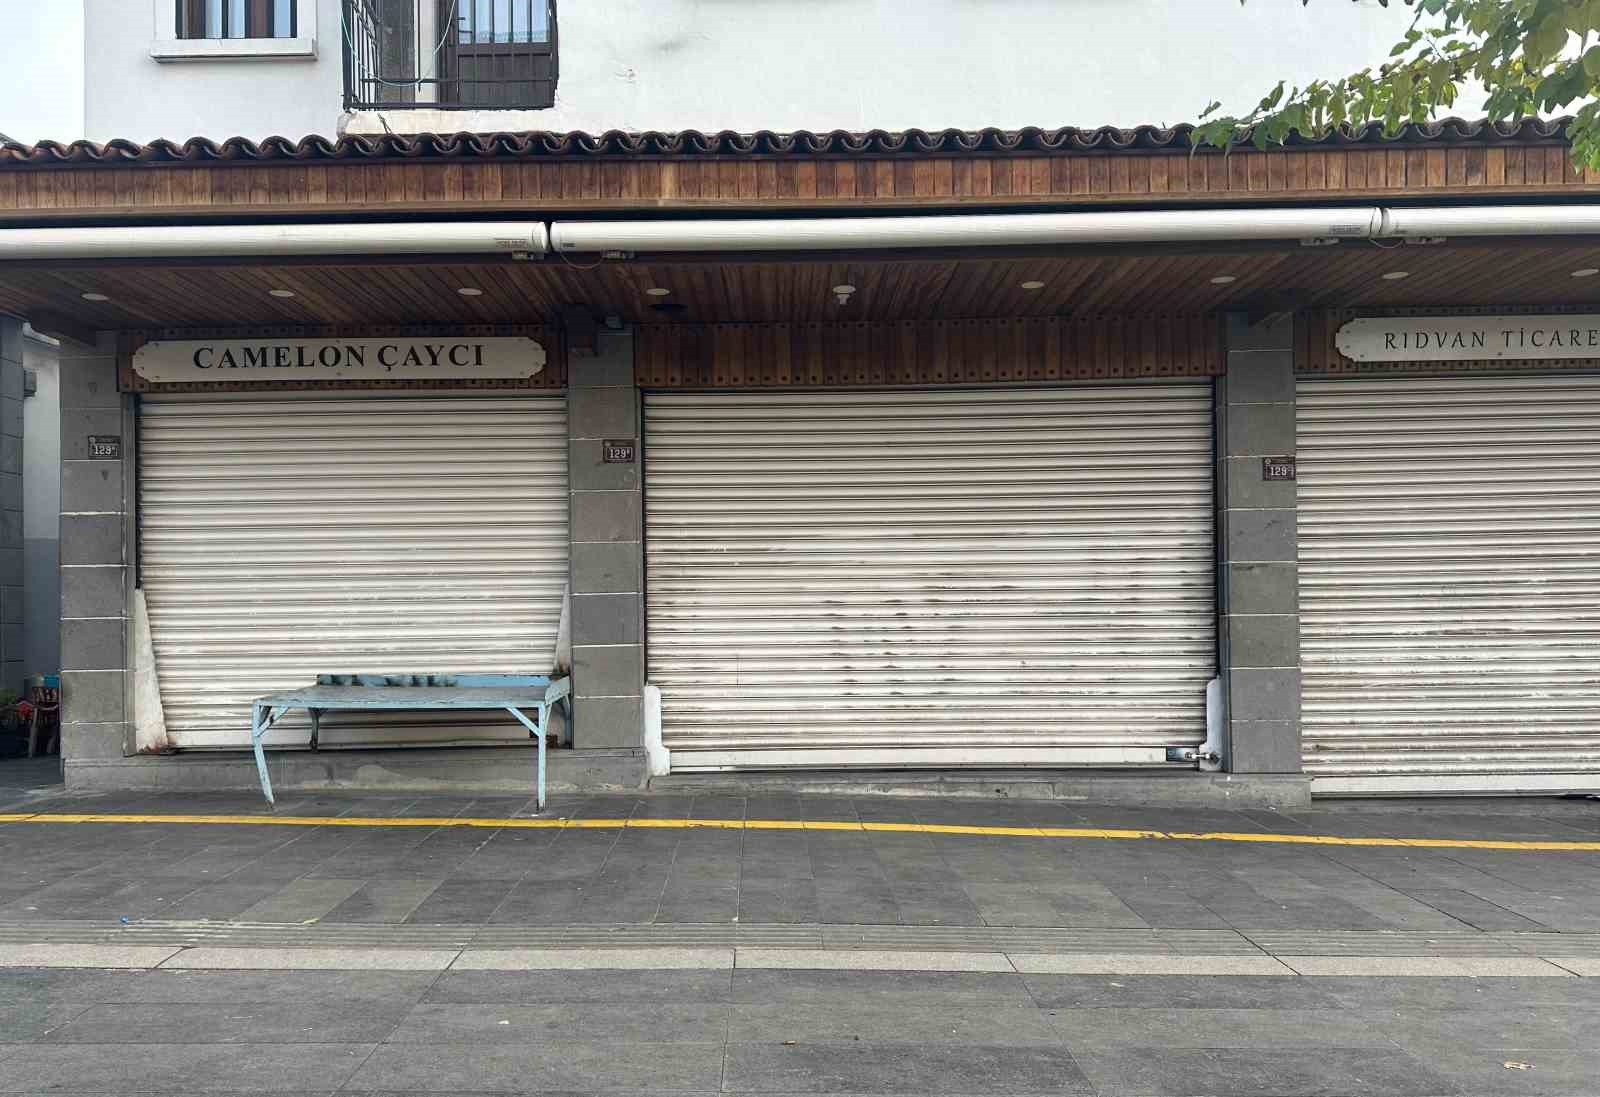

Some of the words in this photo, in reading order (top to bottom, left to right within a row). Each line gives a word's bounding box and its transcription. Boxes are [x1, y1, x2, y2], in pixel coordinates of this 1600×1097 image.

[1385, 332, 1485, 349] RIDVAN
[193, 346, 365, 369] CAMELON
[377, 344, 484, 371] ÇAYCI
